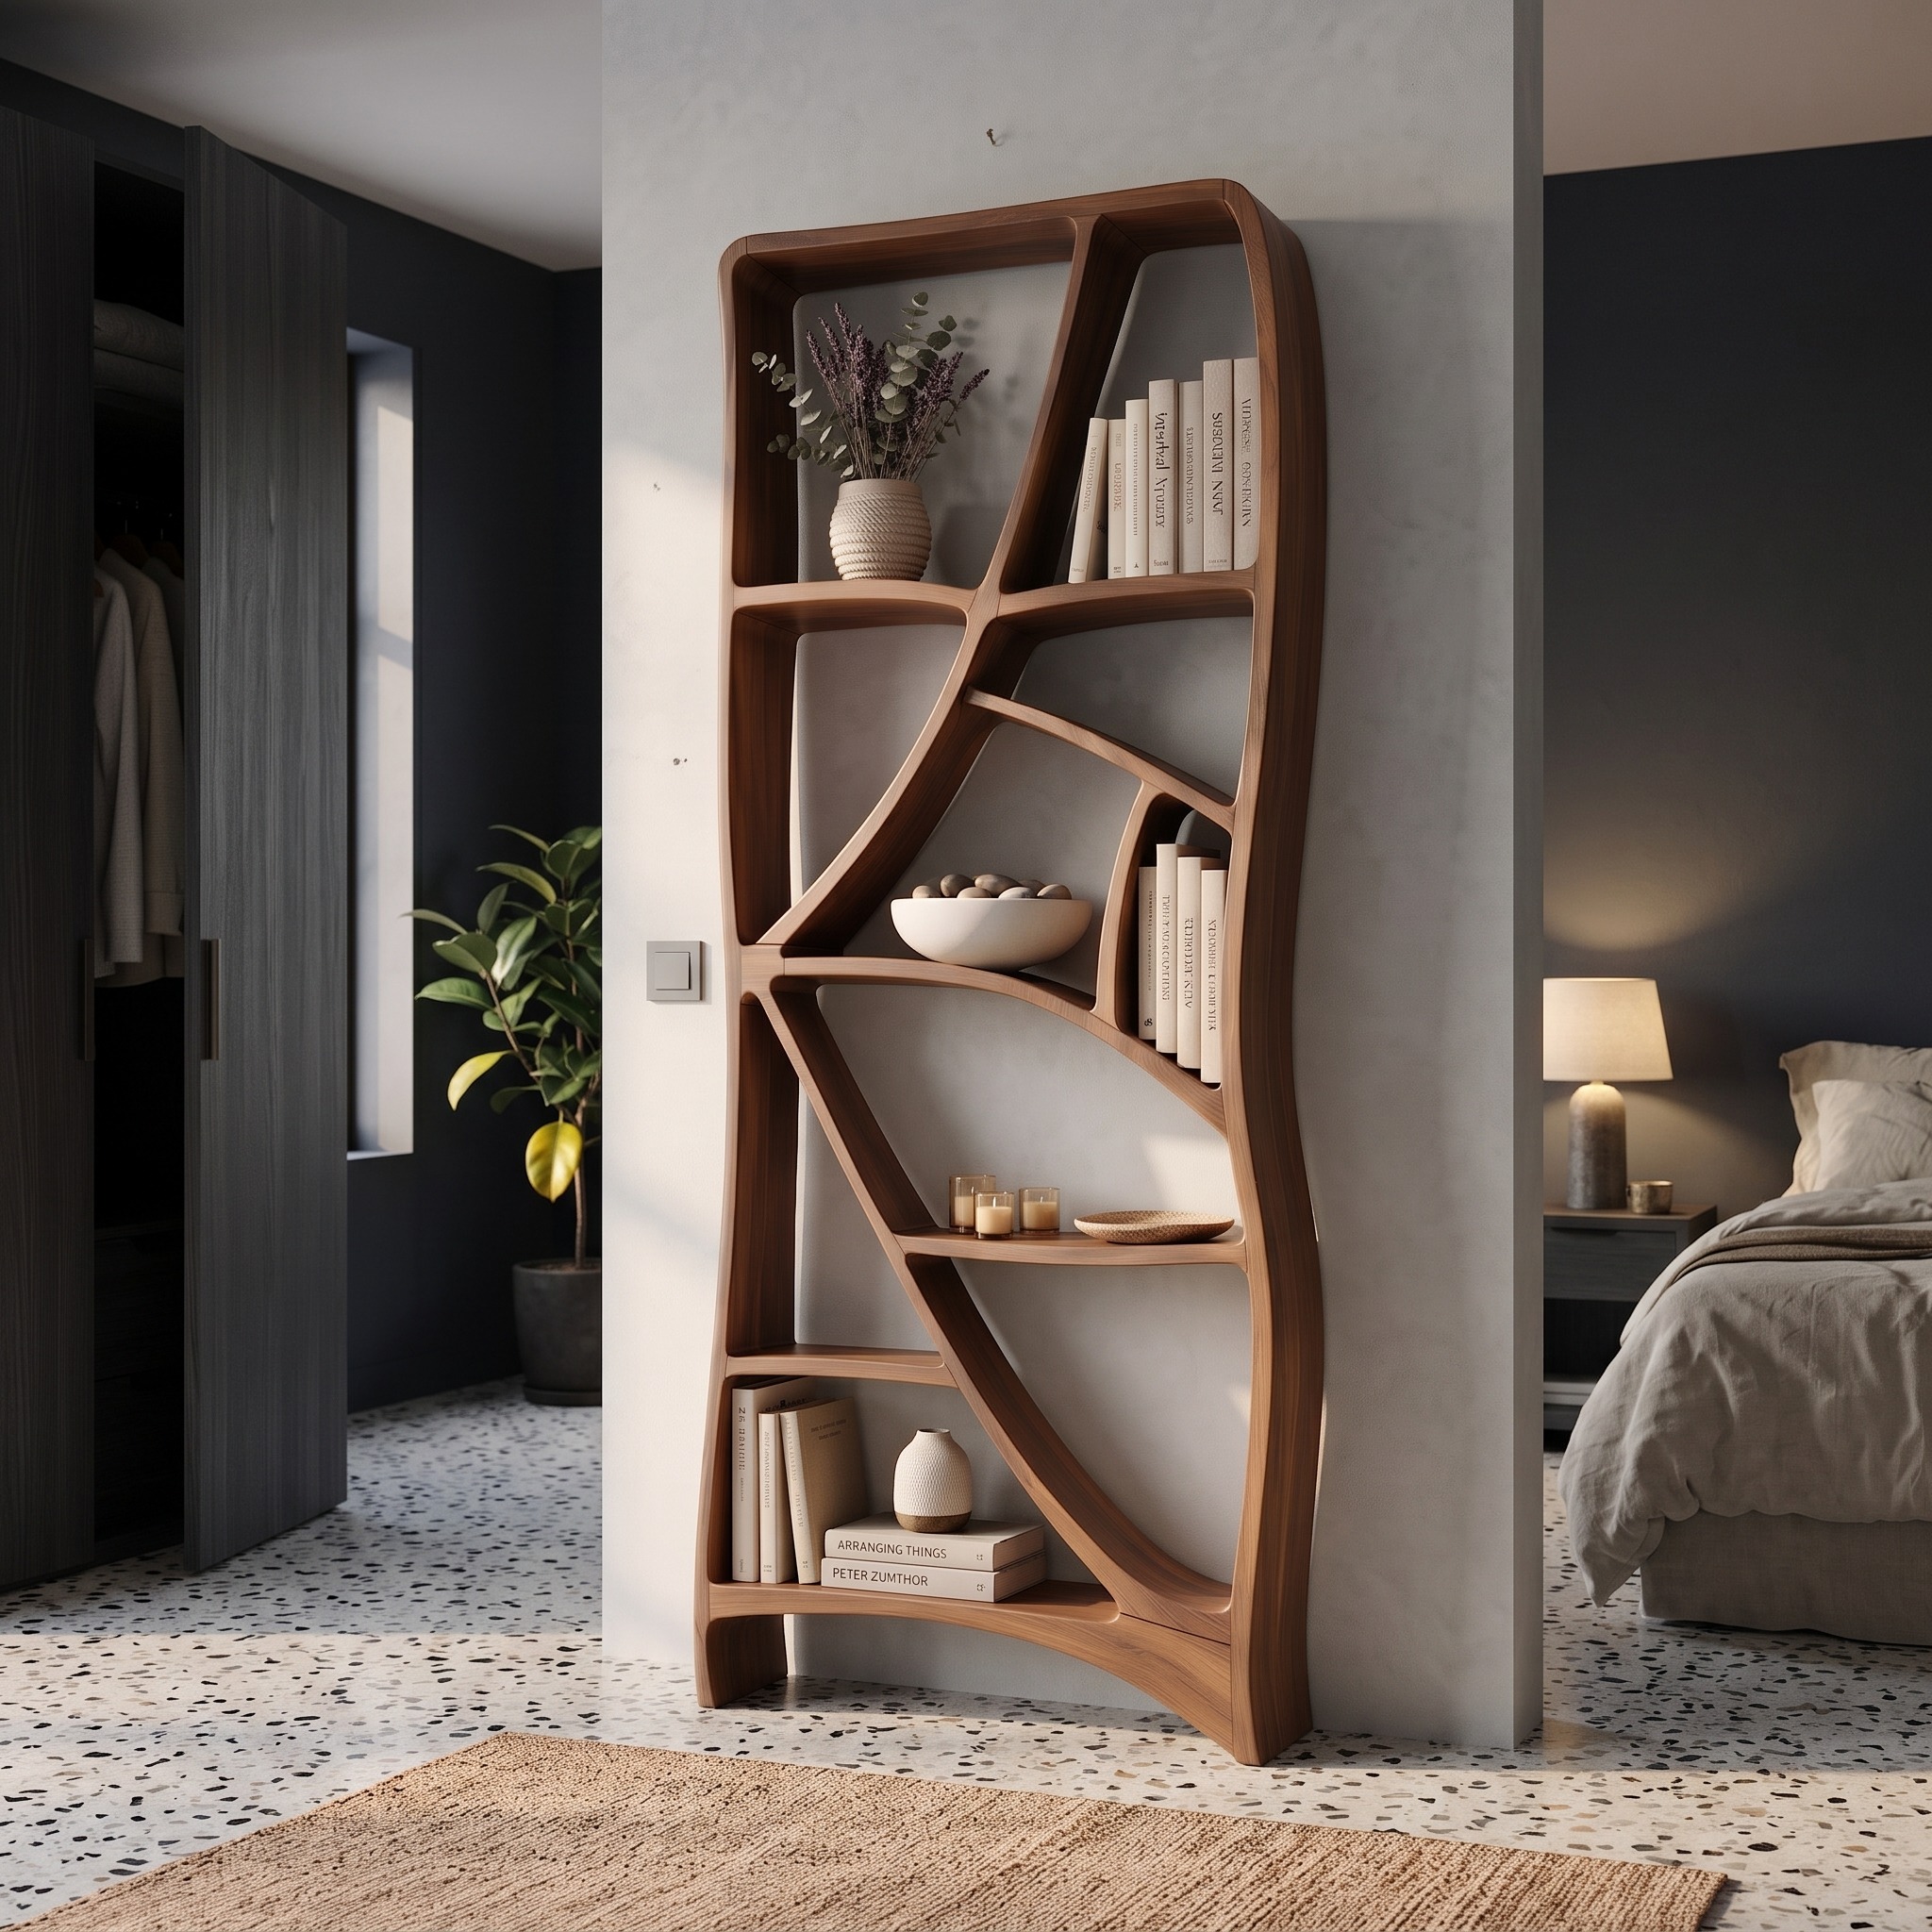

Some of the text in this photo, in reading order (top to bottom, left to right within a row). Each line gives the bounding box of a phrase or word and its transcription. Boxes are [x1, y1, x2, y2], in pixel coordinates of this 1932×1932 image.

[838, 1540, 947, 1558] ARRANGING THINGS
[833, 1567, 928, 1587] PETER ZUMTHOR
